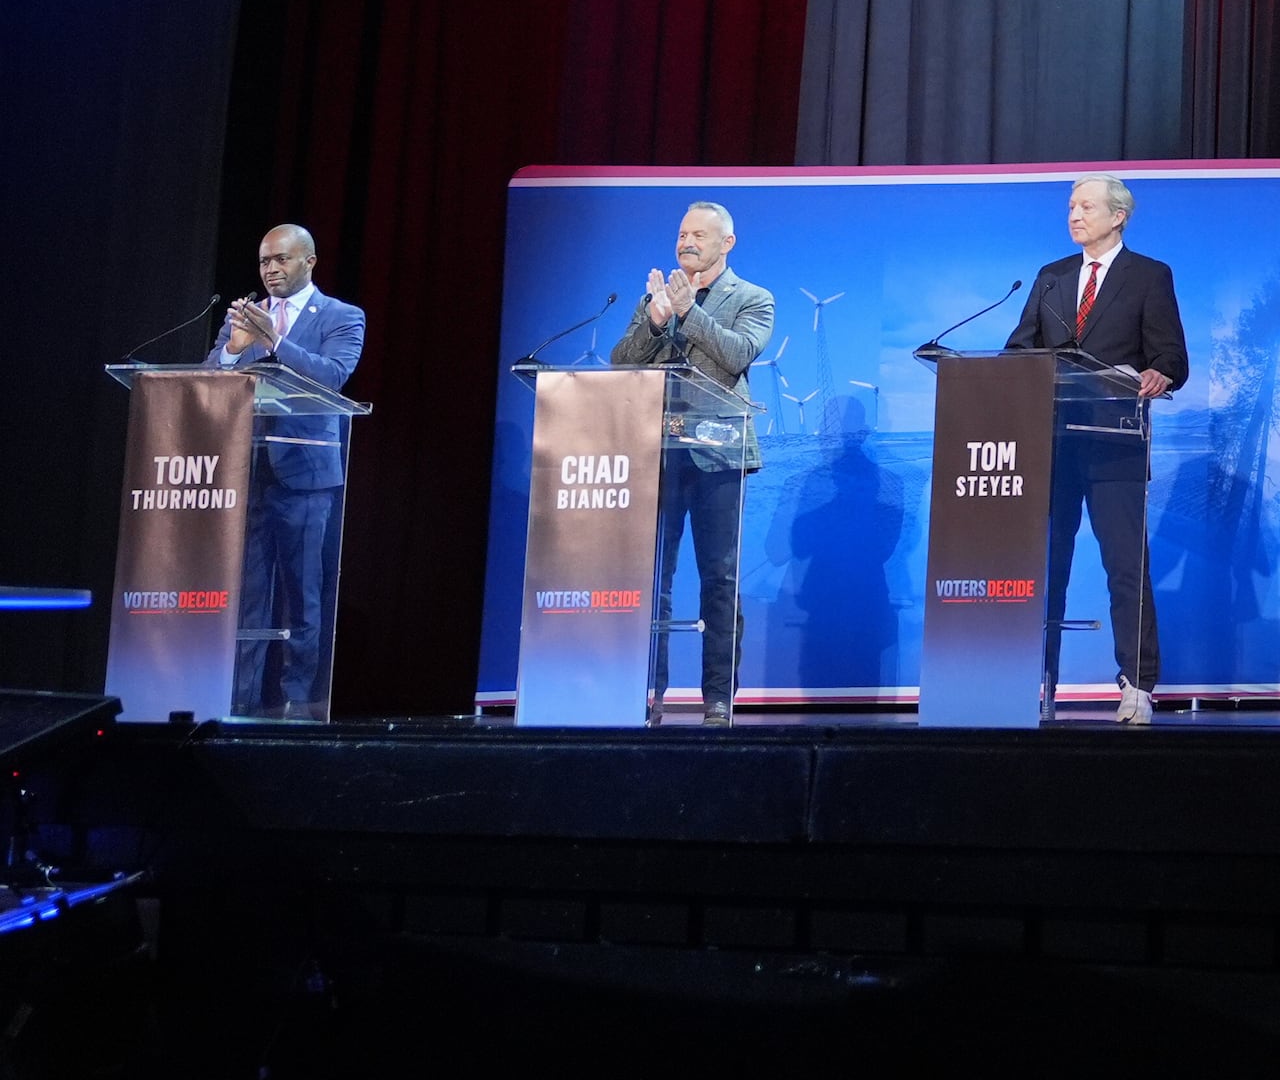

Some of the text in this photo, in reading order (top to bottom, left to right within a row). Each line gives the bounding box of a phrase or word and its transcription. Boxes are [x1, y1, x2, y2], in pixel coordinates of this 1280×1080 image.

[967, 441, 1016, 471] TOM
[154, 455, 219, 485] TONY
[561, 455, 629, 484] CHAD
[956, 475, 1023, 497] STEYER
[131, 488, 236, 510] THURMOND
[557, 488, 630, 509] BIANCO
[936, 579, 1035, 596] VOTERS DECIDE
[123, 590, 228, 608] VOTERS DECIDE
[536, 590, 641, 608] VOTERS DECIDE
